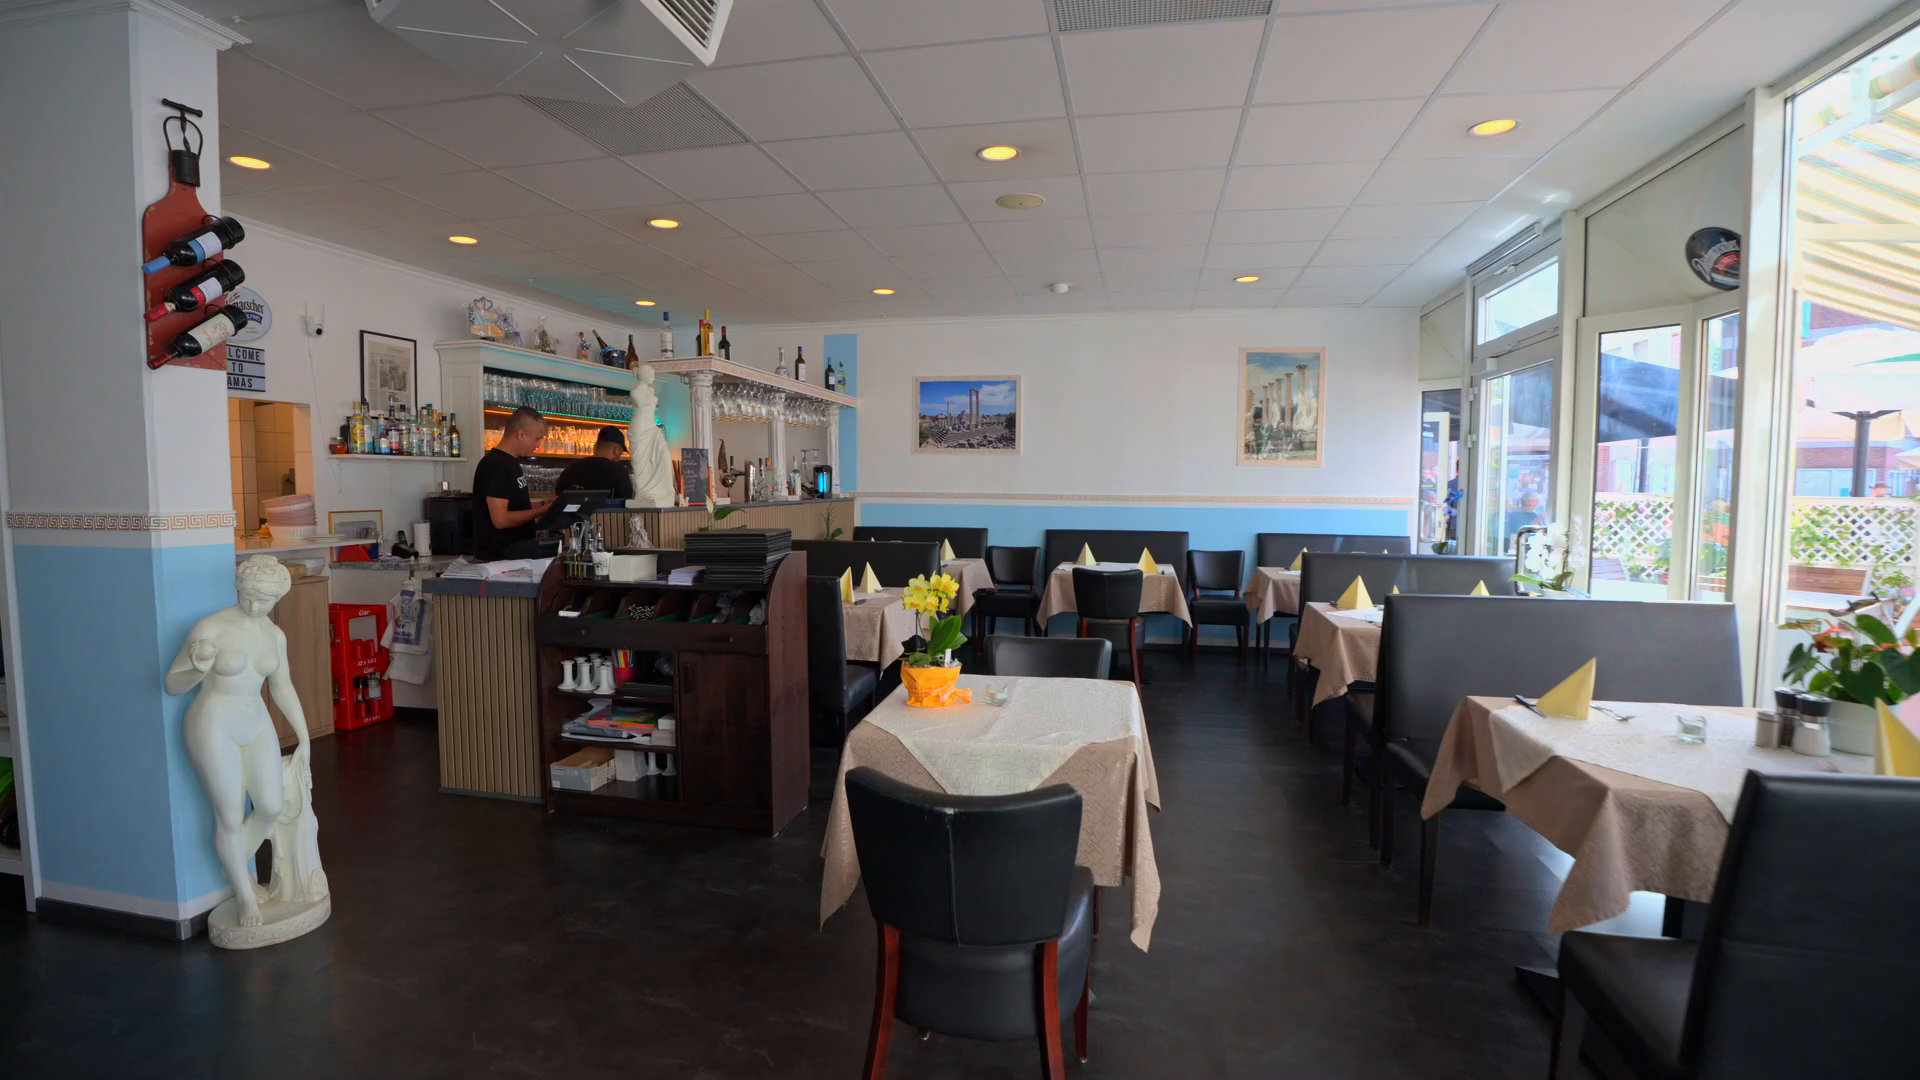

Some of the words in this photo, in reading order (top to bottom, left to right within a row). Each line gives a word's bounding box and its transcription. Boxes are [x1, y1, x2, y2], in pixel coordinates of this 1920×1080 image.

[231, 299, 264, 314] marscher
[228, 346, 260, 361] LCOME
[232, 362, 244, 373] TO
